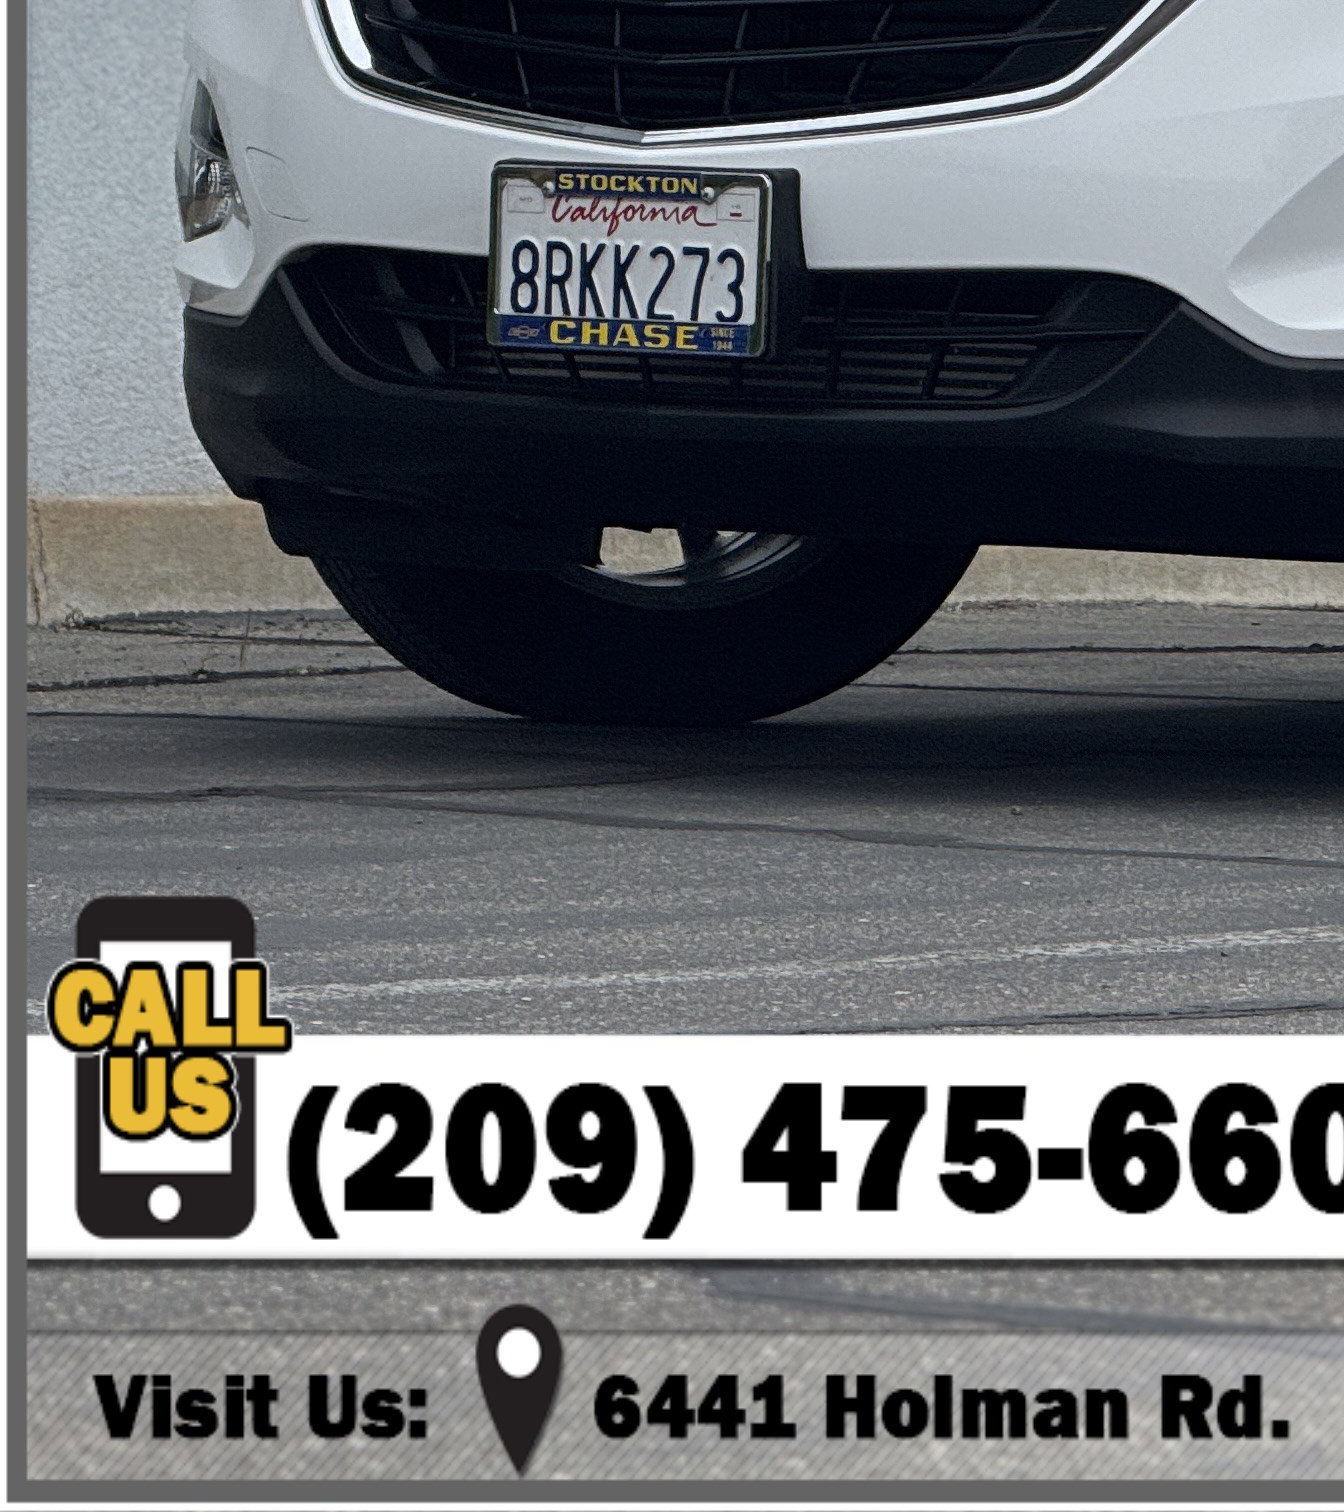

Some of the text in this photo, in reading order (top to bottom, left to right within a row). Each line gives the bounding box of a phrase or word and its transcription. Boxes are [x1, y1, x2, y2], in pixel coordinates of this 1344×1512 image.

[557, 172, 698, 194] STOCKTON
[551, 194, 717, 236] California
[510, 239, 744, 322] 8RKK273
[550, 320, 699, 350] CHASE
